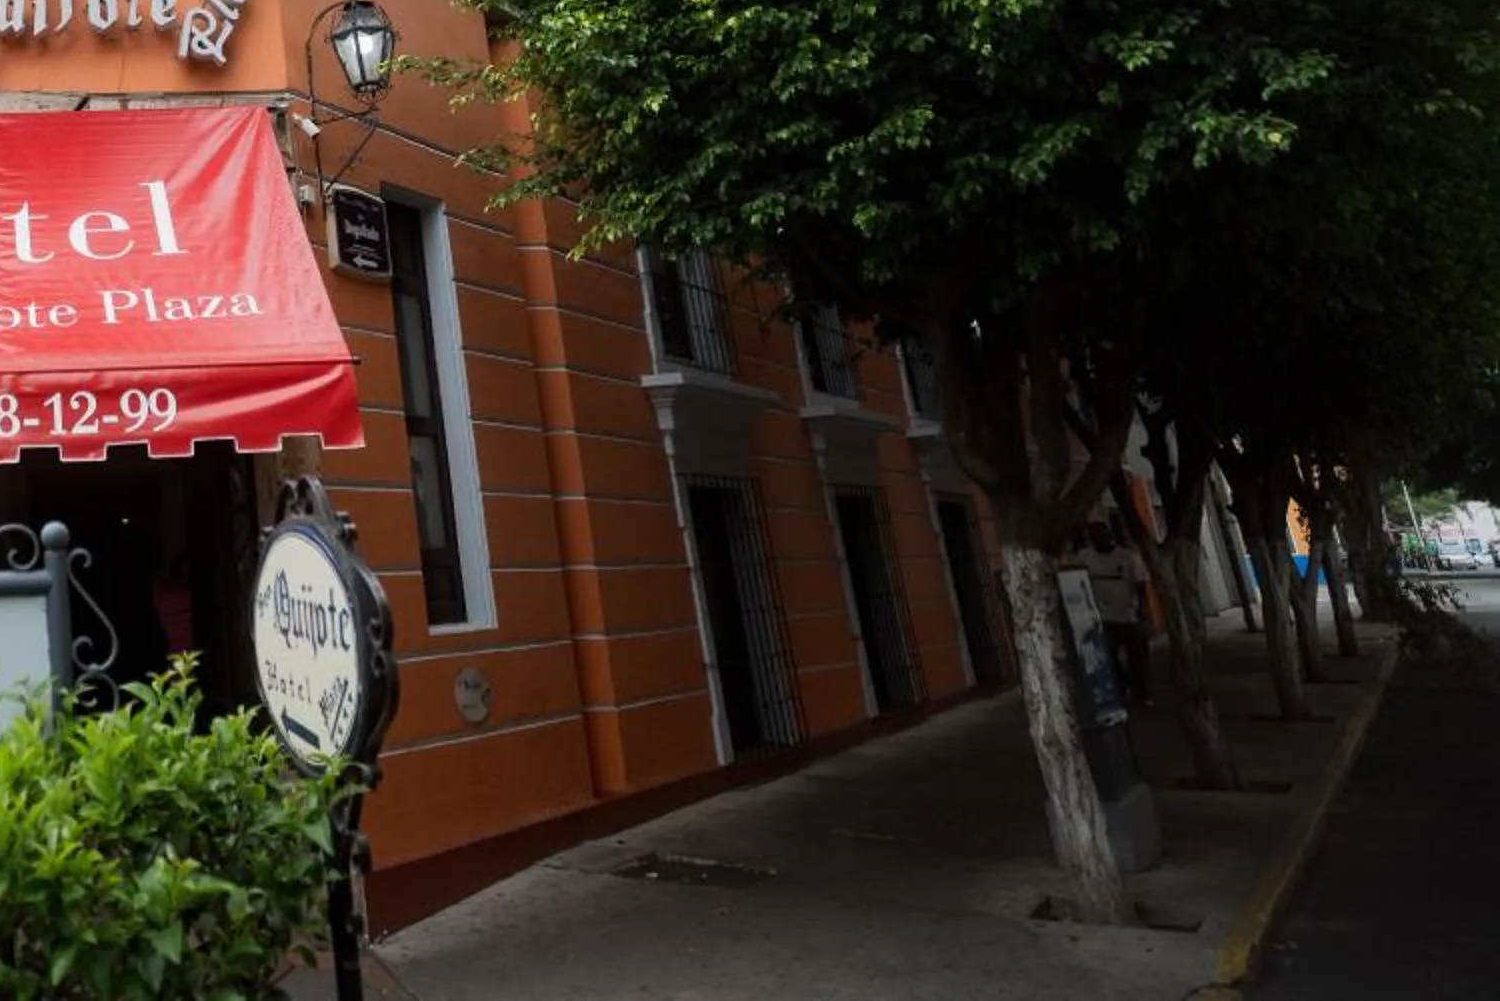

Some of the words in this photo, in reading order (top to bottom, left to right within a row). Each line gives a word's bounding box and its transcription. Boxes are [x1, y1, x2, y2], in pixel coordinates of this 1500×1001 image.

[99, 286, 264, 325] Plaza
[273, 569, 352, 658] Quijote
[264, 659, 312, 705] Hotel
